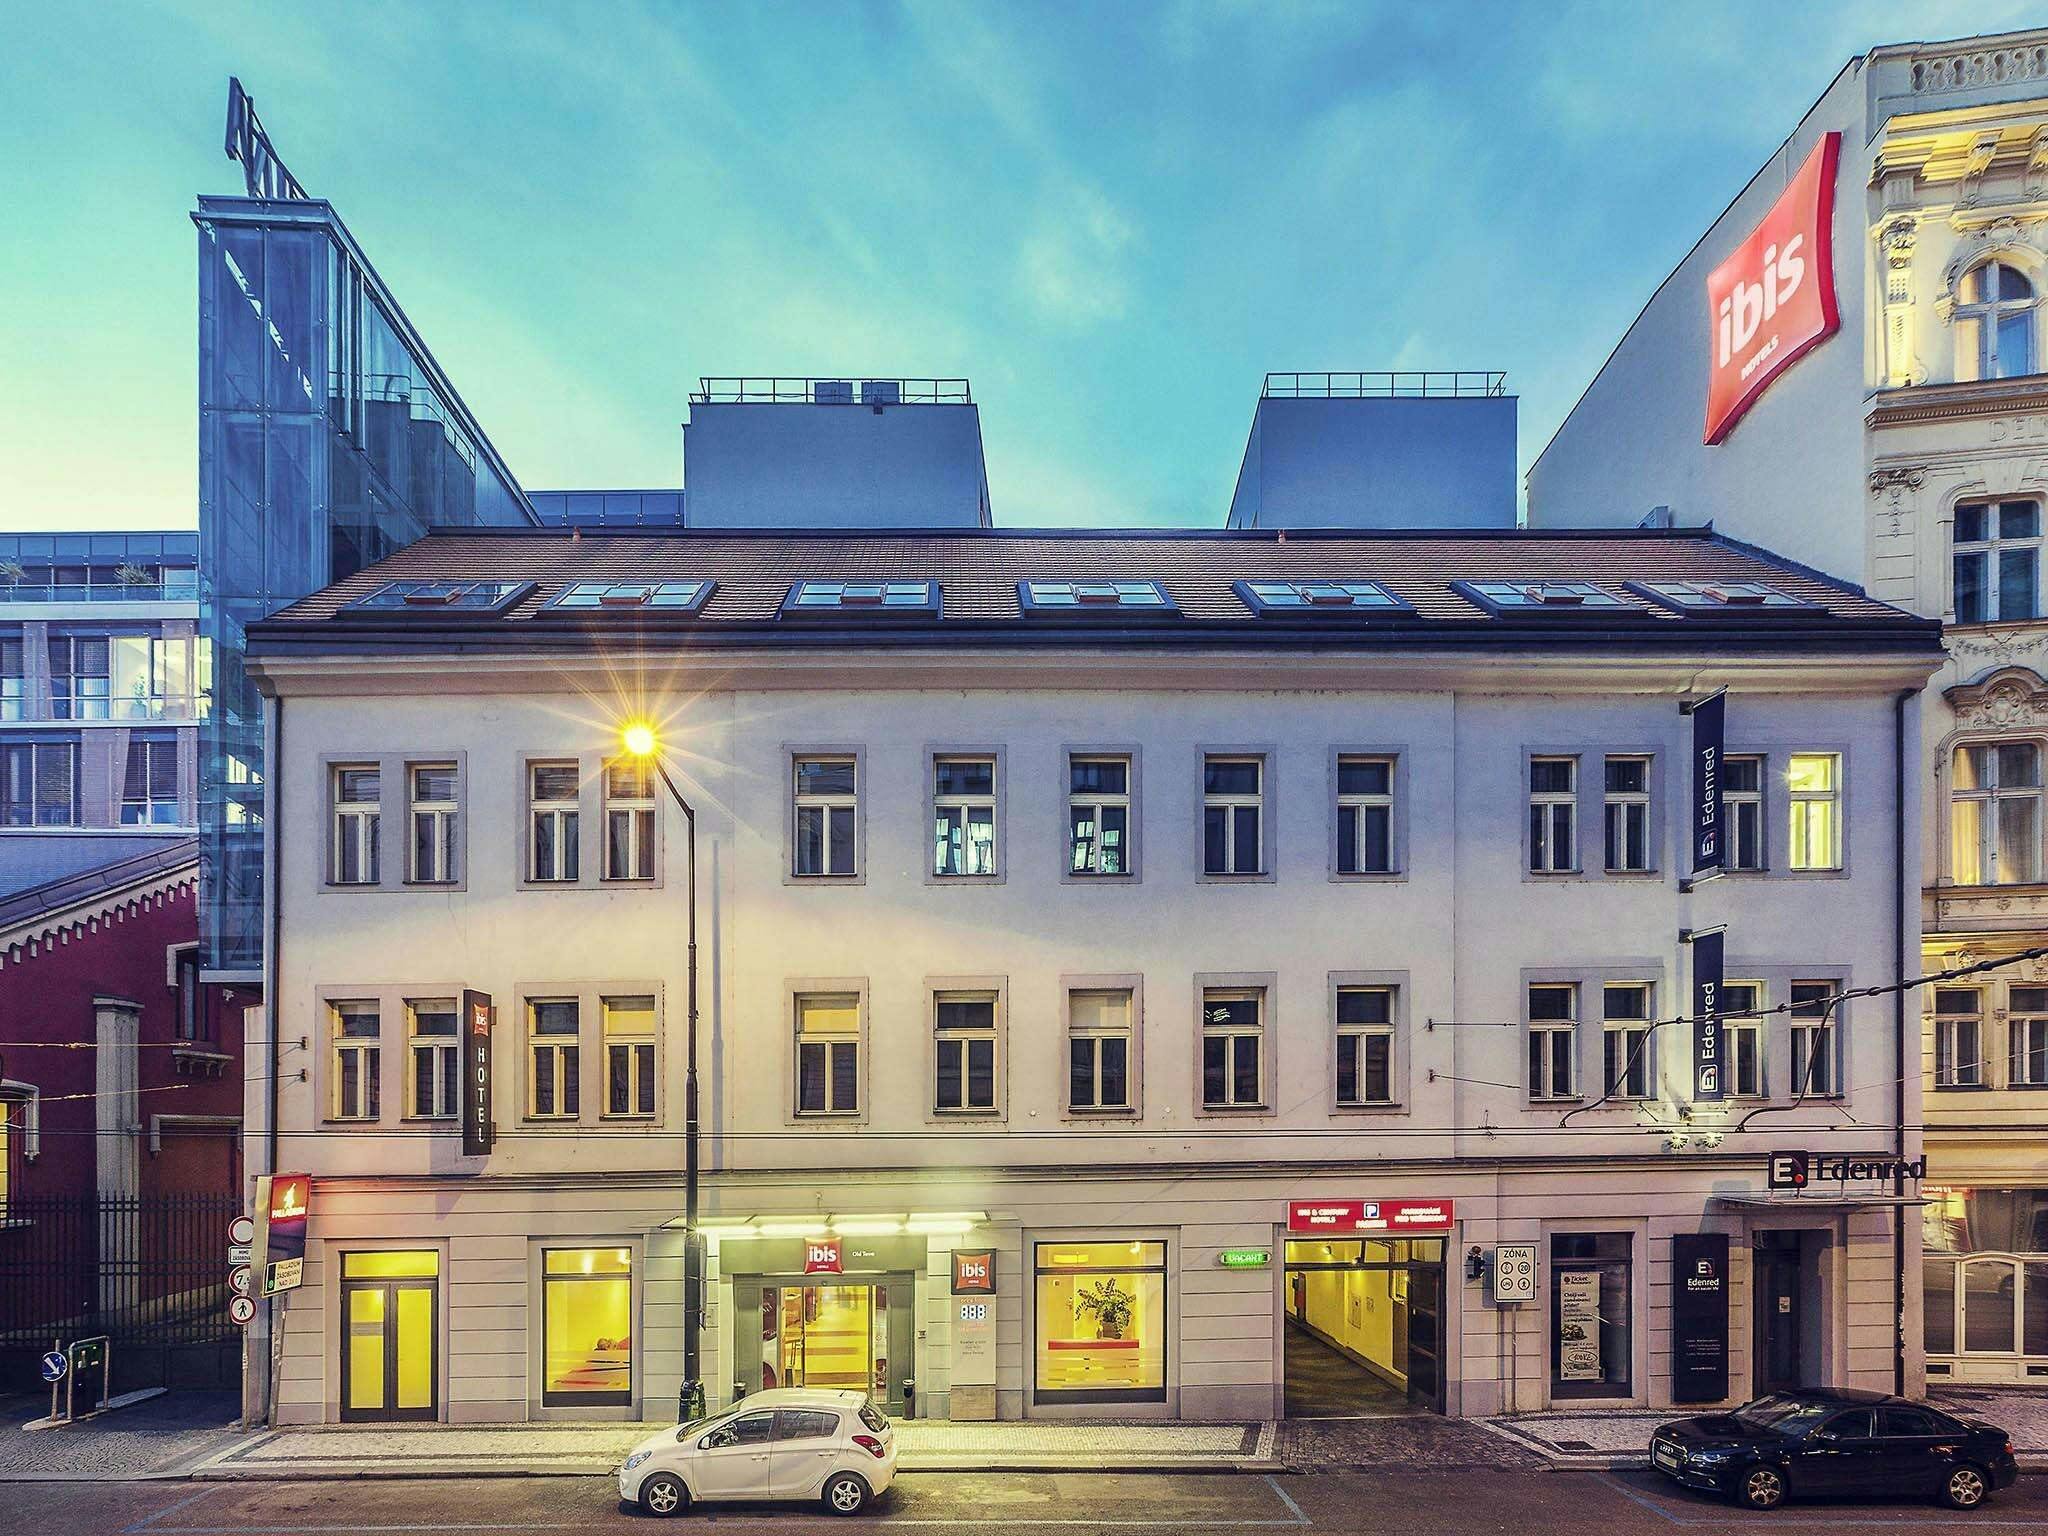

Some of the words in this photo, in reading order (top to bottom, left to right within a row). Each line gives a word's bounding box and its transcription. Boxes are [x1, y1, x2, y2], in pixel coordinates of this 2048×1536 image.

[1719, 233, 1804, 368] ibis
[1741, 335, 1779, 381] HOTELS
[1702, 746, 1715, 826] Edenred
[1702, 982, 1715, 1060] Edenred
[477, 1047, 485, 1143] HOTEL
[1816, 1155, 1927, 1181] Edenred
[808, 1245, 837, 1262] ibis
[961, 1263, 986, 1278] ibis
[1503, 1248, 1528, 1258] ZÓNA
[1687, 1278, 1720, 1287] Edenred
